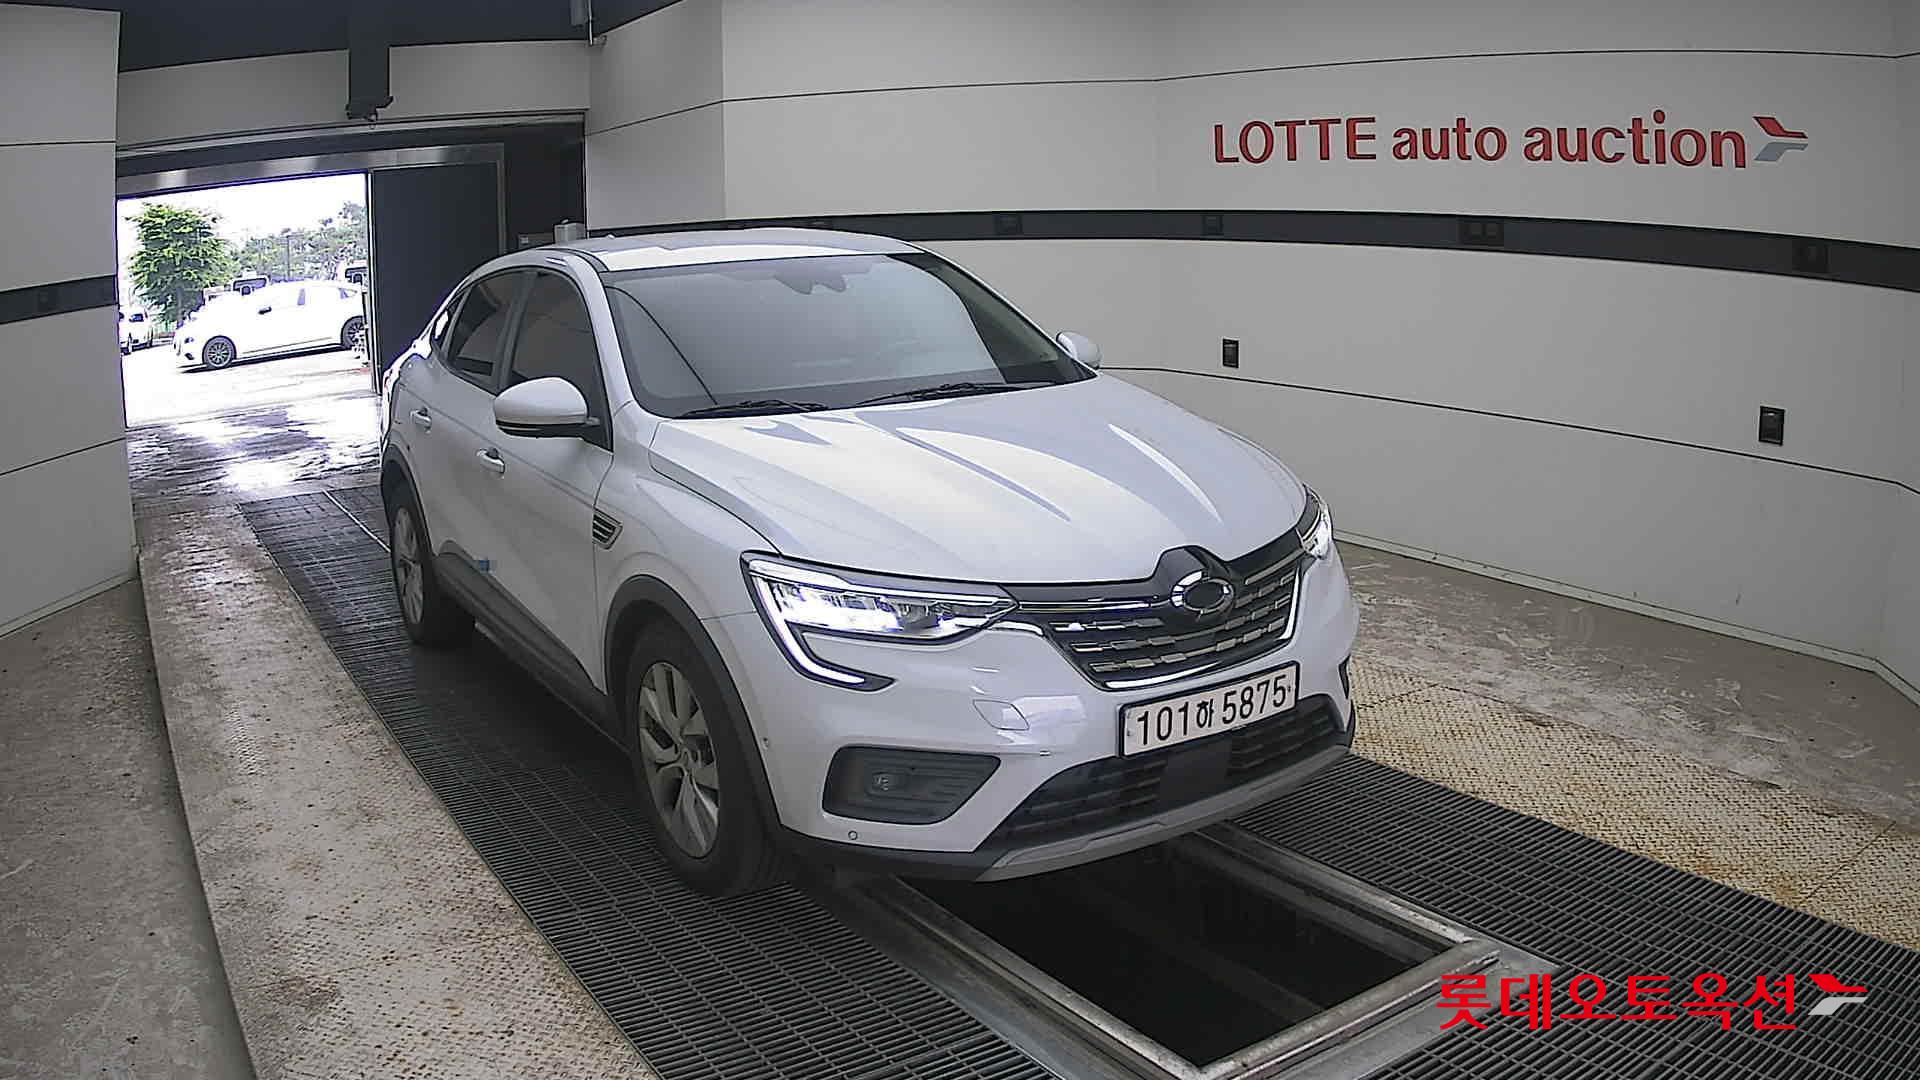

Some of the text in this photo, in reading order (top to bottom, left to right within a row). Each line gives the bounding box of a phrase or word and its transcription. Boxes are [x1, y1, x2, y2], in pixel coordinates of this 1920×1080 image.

[1213, 109, 1746, 169] LOTTE auto auction
[1222, 674, 1287, 725] 5875
